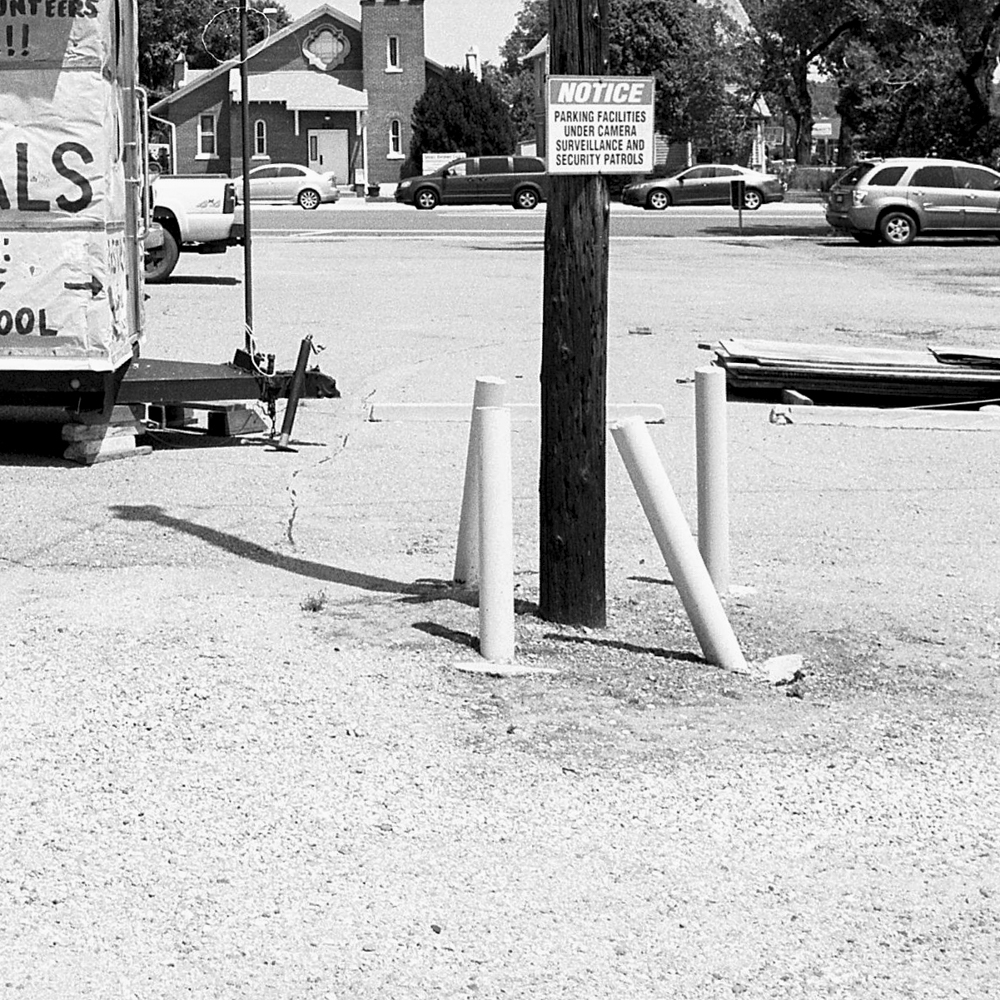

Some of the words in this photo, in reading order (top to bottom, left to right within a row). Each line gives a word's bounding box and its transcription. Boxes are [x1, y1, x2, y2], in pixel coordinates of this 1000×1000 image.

[558, 82, 645, 103] NOTICE
[554, 111, 594, 122] PARKING
[597, 111, 646, 122] FACILITIES
[564, 125, 595, 137] UNDER
[597, 125, 637, 137] CAMERA
[556, 139, 623, 151] SURVEILLANCE
[626, 139, 645, 151] AND
[556, 153, 600, 166] SECURITY
[604, 153, 643, 165] PATROLS
